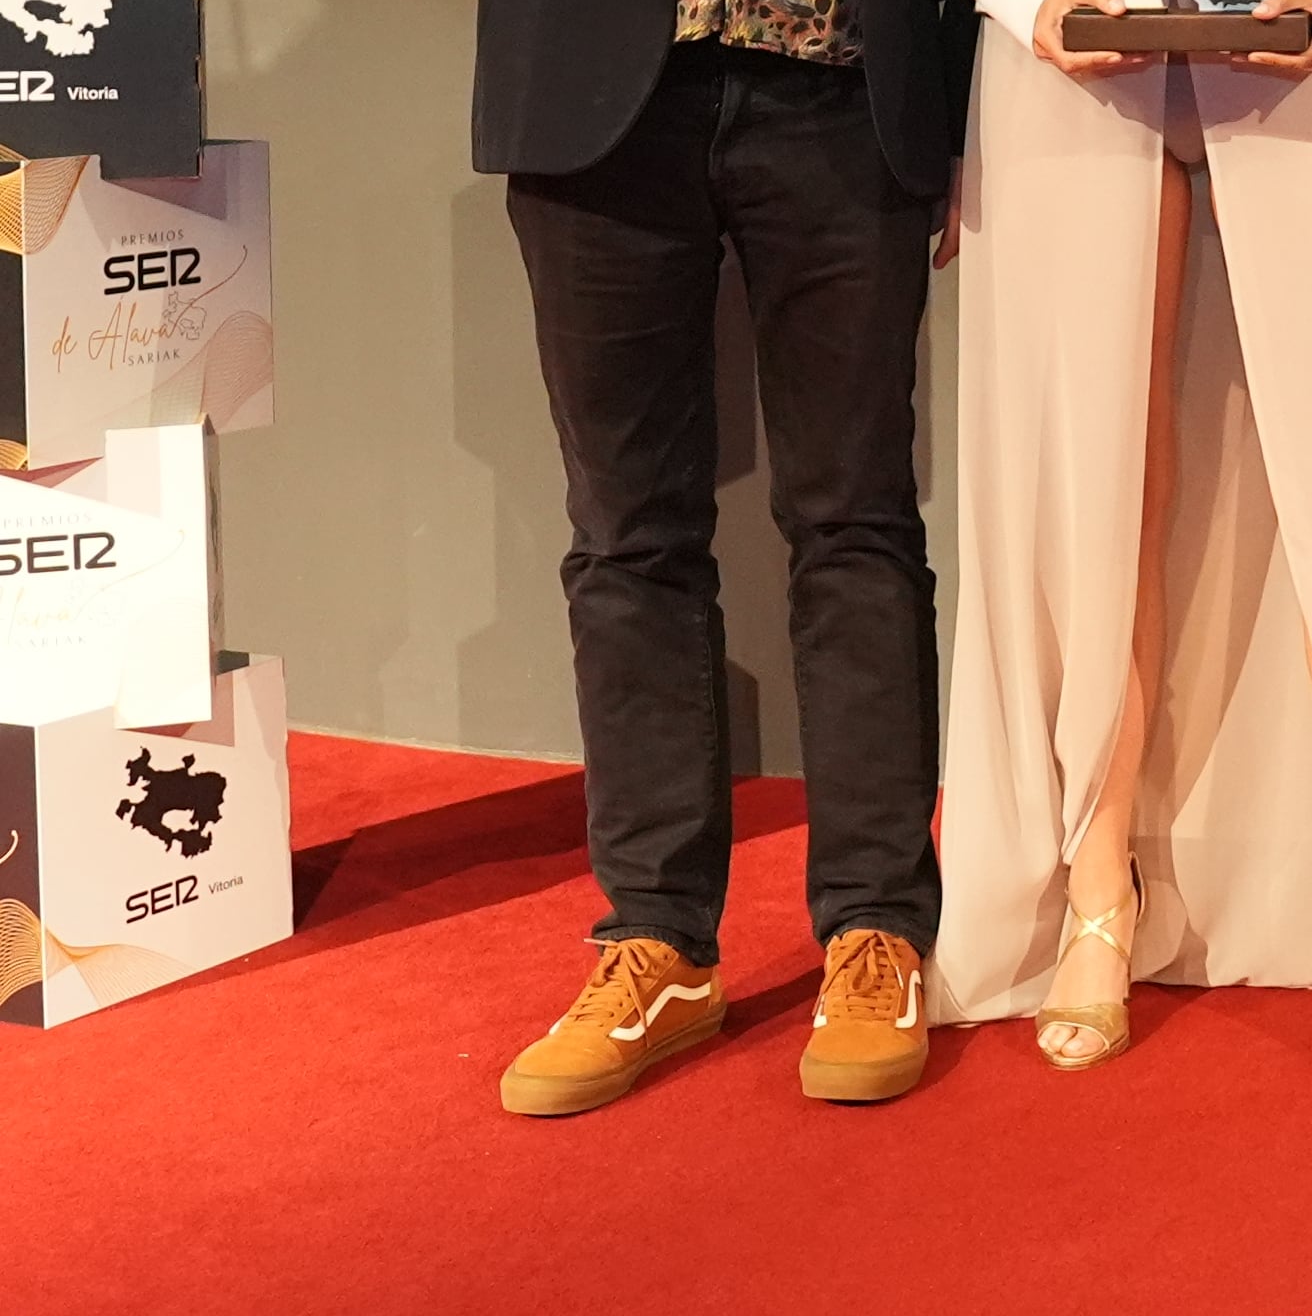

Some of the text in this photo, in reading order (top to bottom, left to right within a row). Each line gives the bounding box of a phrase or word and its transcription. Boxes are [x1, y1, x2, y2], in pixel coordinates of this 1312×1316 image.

[0, 70, 119, 102] ER Vitoria
[121, 229, 185, 246] PREMIOS
[103, 247, 202, 295] SER
[52, 316, 77, 373] de
[128, 348, 181, 366] SARIAK
[0, 531, 117, 577] SER
[126, 874, 244, 924] SER Vitoria
